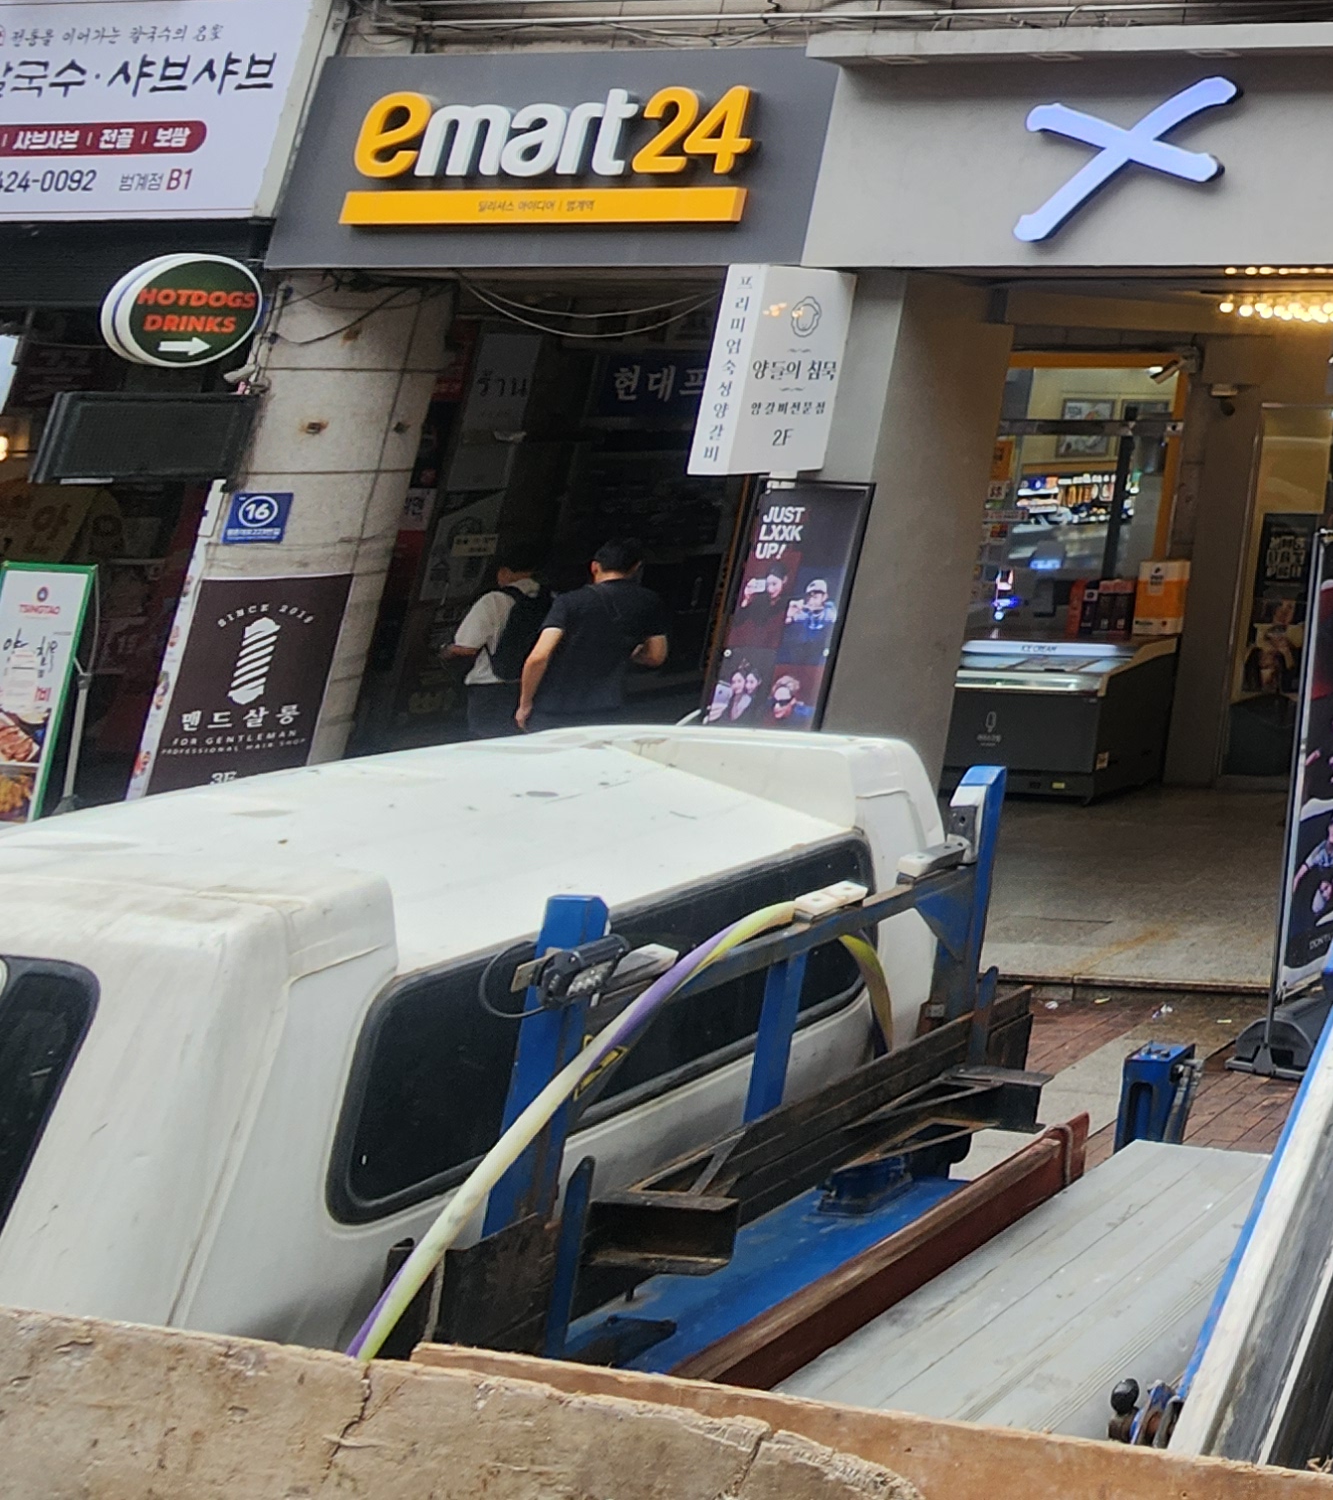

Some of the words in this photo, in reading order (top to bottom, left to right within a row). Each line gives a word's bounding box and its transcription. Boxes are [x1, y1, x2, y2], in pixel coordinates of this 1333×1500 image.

[62, 26, 121, 44] 이어가는
[107, 52, 277, 97] 샤브샤브
[12, 131, 80, 150] 샤브샤브
[99, 128, 134, 149] 전골
[153, 127, 191, 147] 보쌈
[353, 85, 754, 179] emart24
[119, 173, 164, 191] 범계점
[167, 169, 193, 190] B1
[137, 287, 257, 309] HOTDOGS
[143, 314, 236, 333] DRINKS
[772, 429, 794, 446] 2F
[243, 500, 271, 521] 16
[763, 506, 805, 523] JUST
[759, 525, 803, 541] LXXK
[755, 543, 786, 560] UP!
[19, 603, 60, 616] TSINGTAO
[217, 603, 269, 629] SINCE
[181, 704, 301, 732] 맨드살롱
[172, 735, 200, 747] FOR
[205, 729, 297, 744] GENTLEMAN
